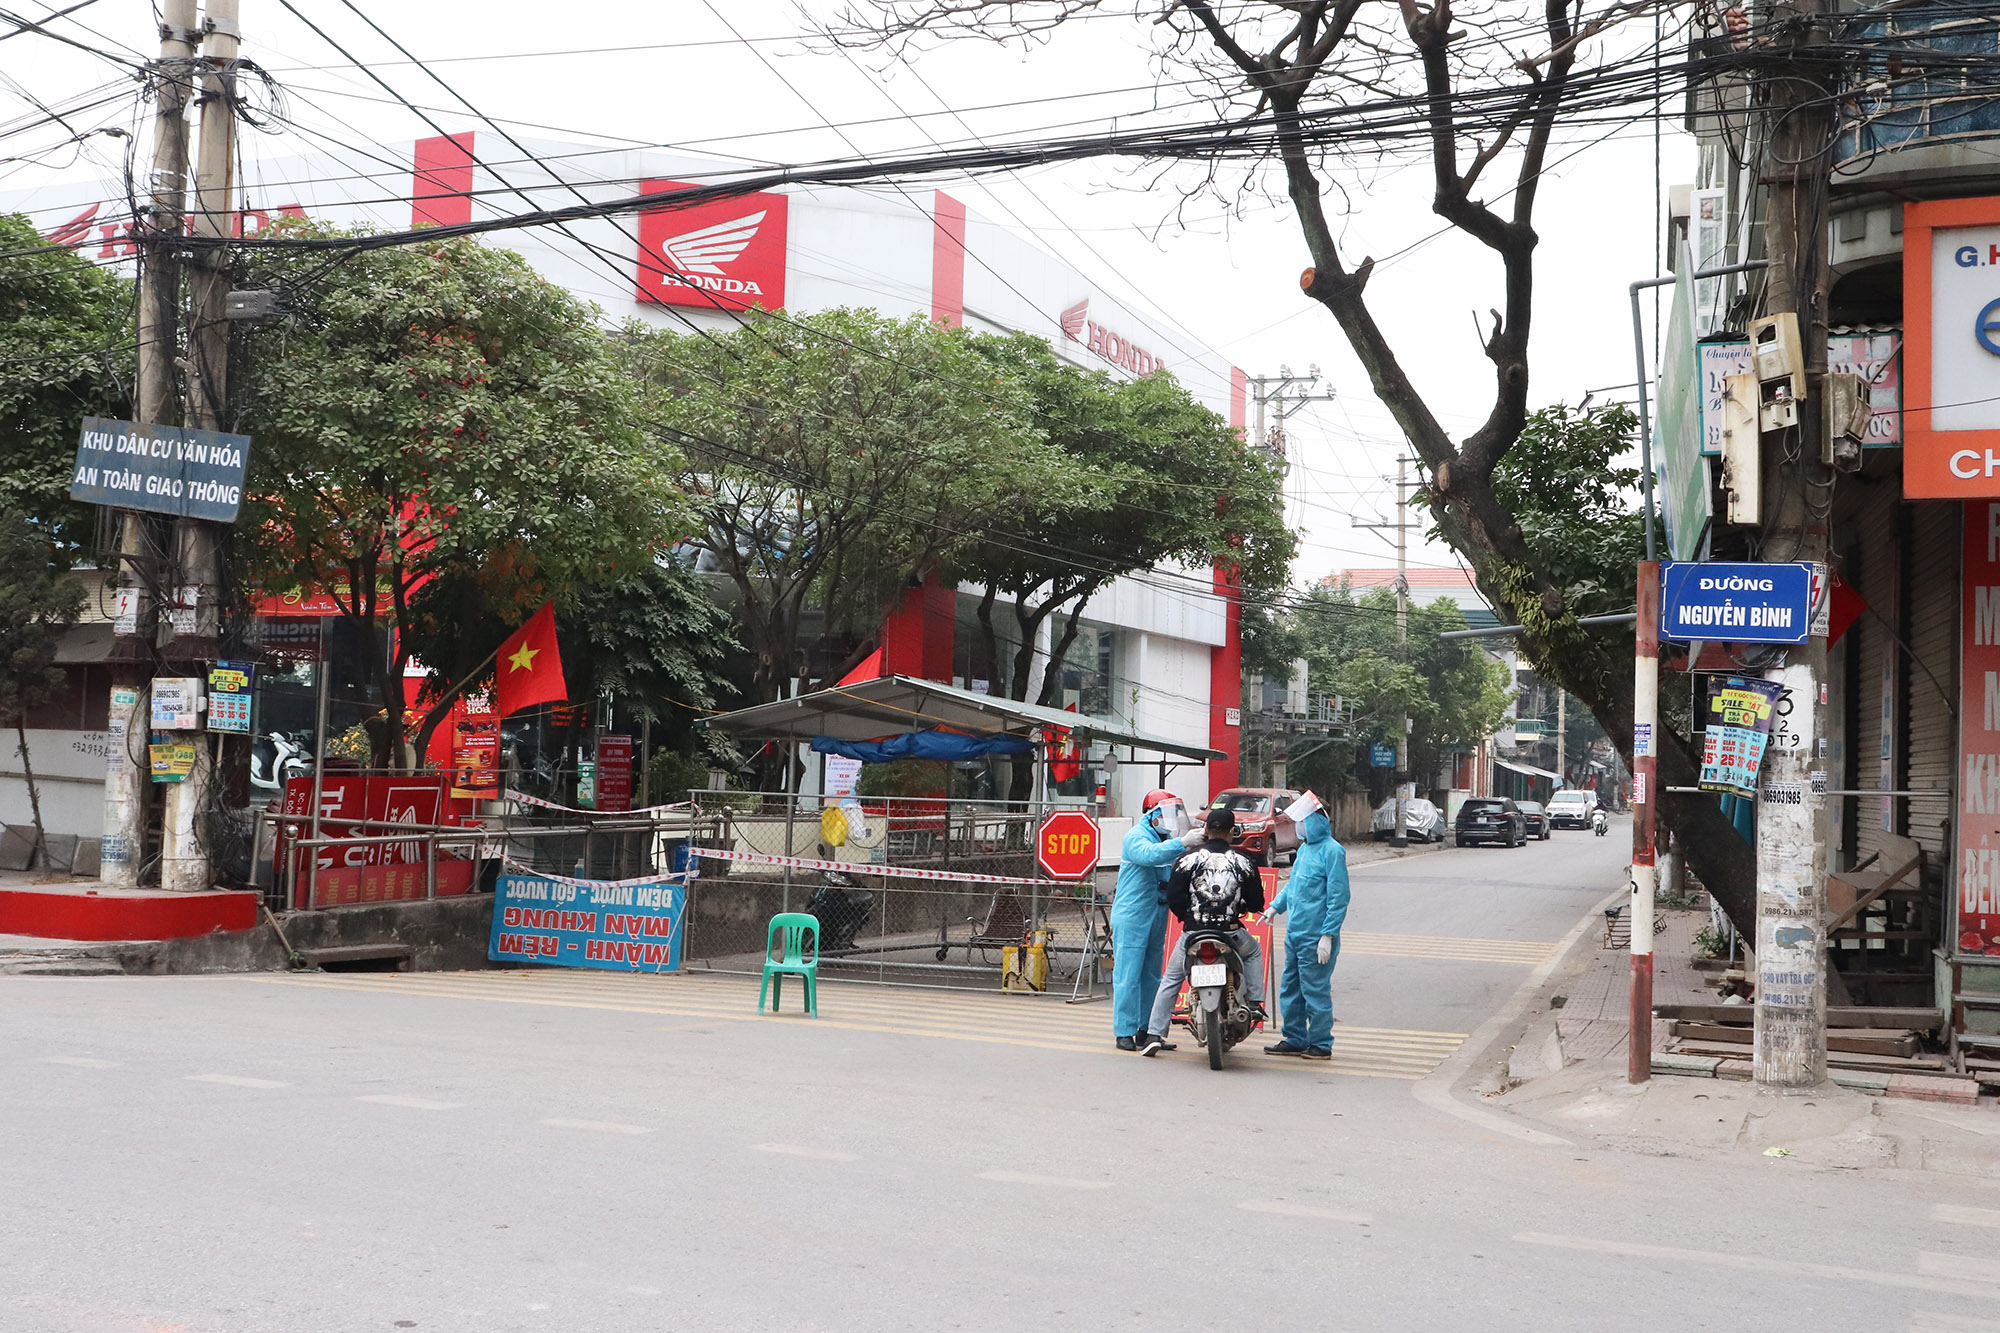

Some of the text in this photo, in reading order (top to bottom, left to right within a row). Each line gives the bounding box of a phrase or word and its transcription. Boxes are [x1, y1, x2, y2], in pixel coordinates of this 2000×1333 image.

[661, 273, 764, 295] HONDA
[1087, 320, 1166, 378] HONDA
[83, 431, 241, 468] KHU DÂN CƯ VĂN HÓA
[75, 466, 240, 505] AN TOÀN GIAO THÔNG
[1699, 576, 1774, 592] ĐƯỜNG
[1679, 599, 1792, 628] NGUYỄN BÌNH
[1721, 699, 1744, 708] SALE
[1764, 790, 1801, 804] 0869031985
[1048, 834, 1090, 854] STOP
[506, 879, 548, 902] NƯỚC
[551, 880, 576, 908] GỐI
[590, 886, 633, 908] NƯỚC
[637, 886, 672, 911] ĐỆM
[504, 906, 671, 940] MÀN KHUNG
[498, 933, 560, 959] RÈM
[585, 939, 670, 968] MÀNH
[1775, 973, 1788, 984] VAY
